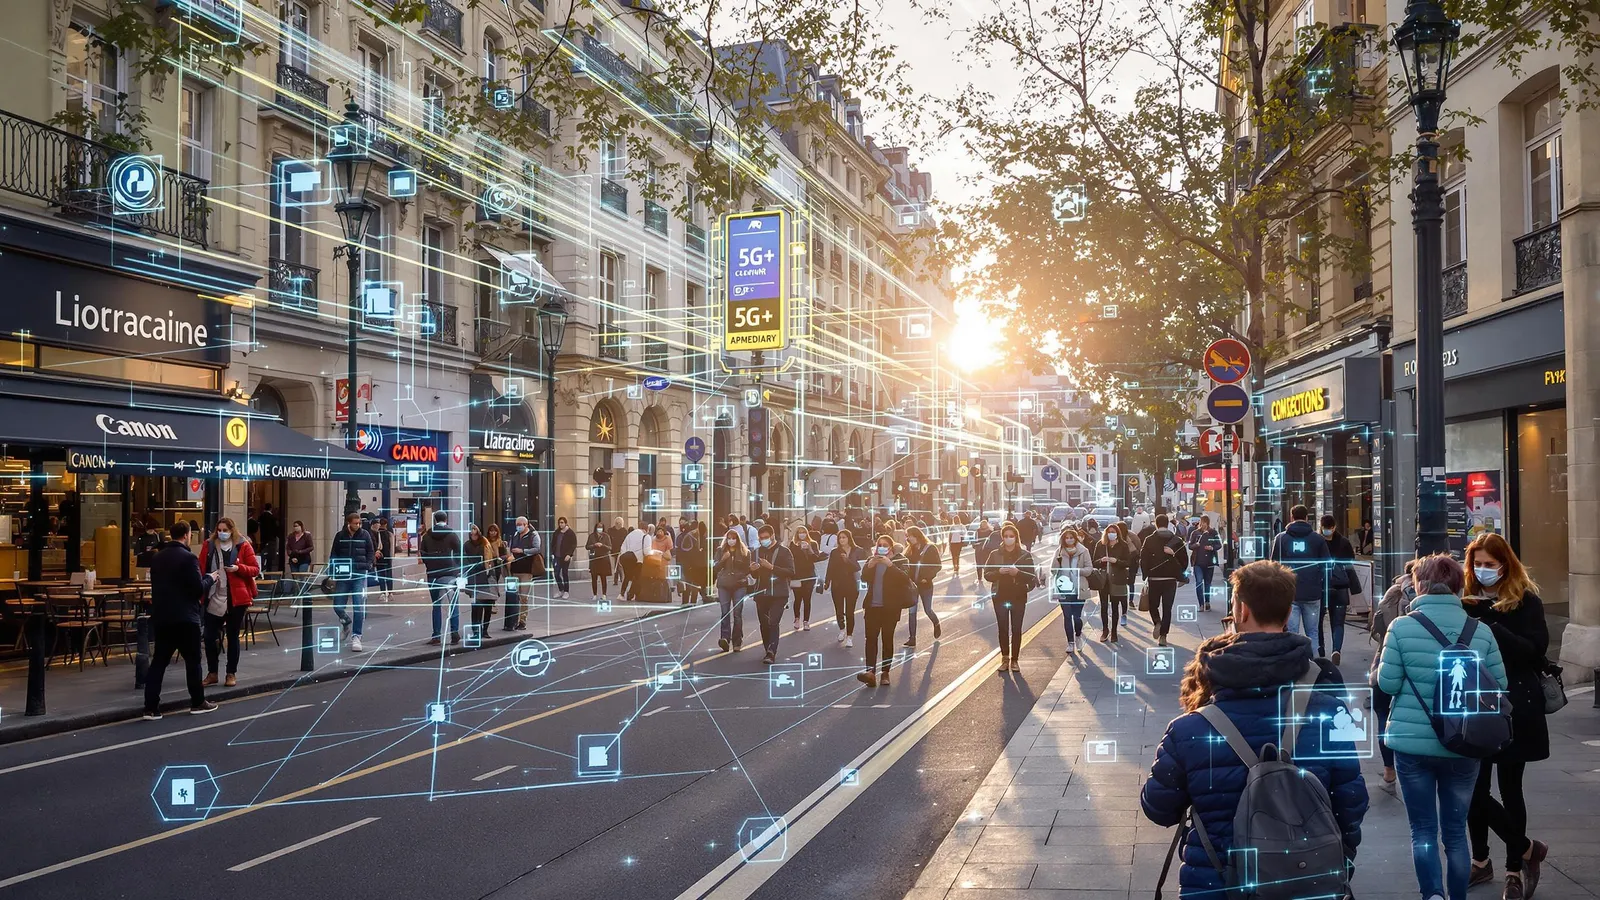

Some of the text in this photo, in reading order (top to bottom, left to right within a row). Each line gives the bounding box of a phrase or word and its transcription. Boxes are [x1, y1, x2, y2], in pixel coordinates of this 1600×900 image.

[738, 246, 775, 267] 5G+
[734, 306, 774, 328] 5G+
[730, 334, 777, 345] APMEDIARY
[95, 413, 179, 440] Canon
[392, 444, 438, 462] CANON
